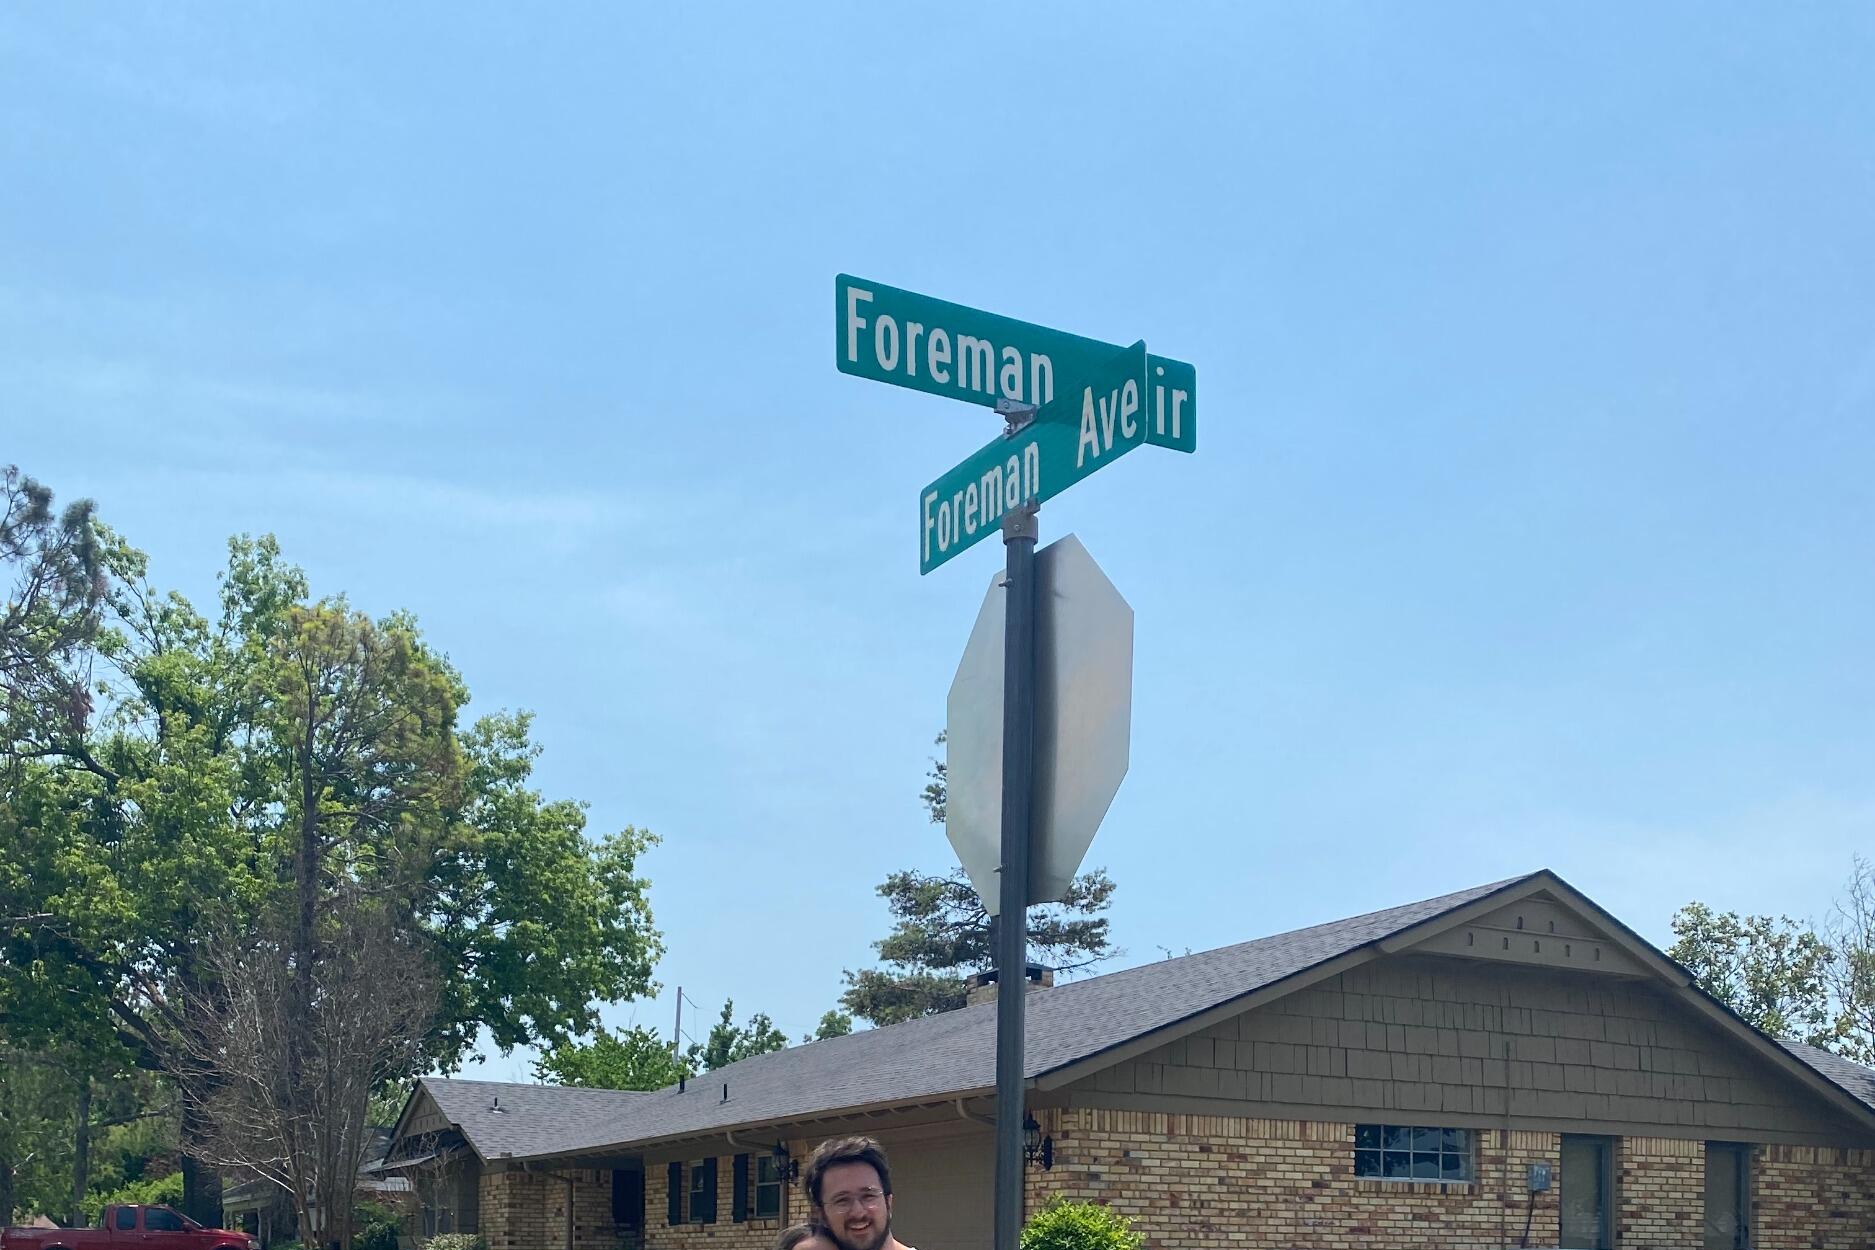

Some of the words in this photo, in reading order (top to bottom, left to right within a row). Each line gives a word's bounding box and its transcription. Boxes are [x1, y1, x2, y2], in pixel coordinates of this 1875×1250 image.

[846, 286, 1054, 405] Foreman
[1156, 367, 1188, 439] ir
[924, 441, 1040, 562] Foreman
[1076, 378, 1139, 468] Ave
